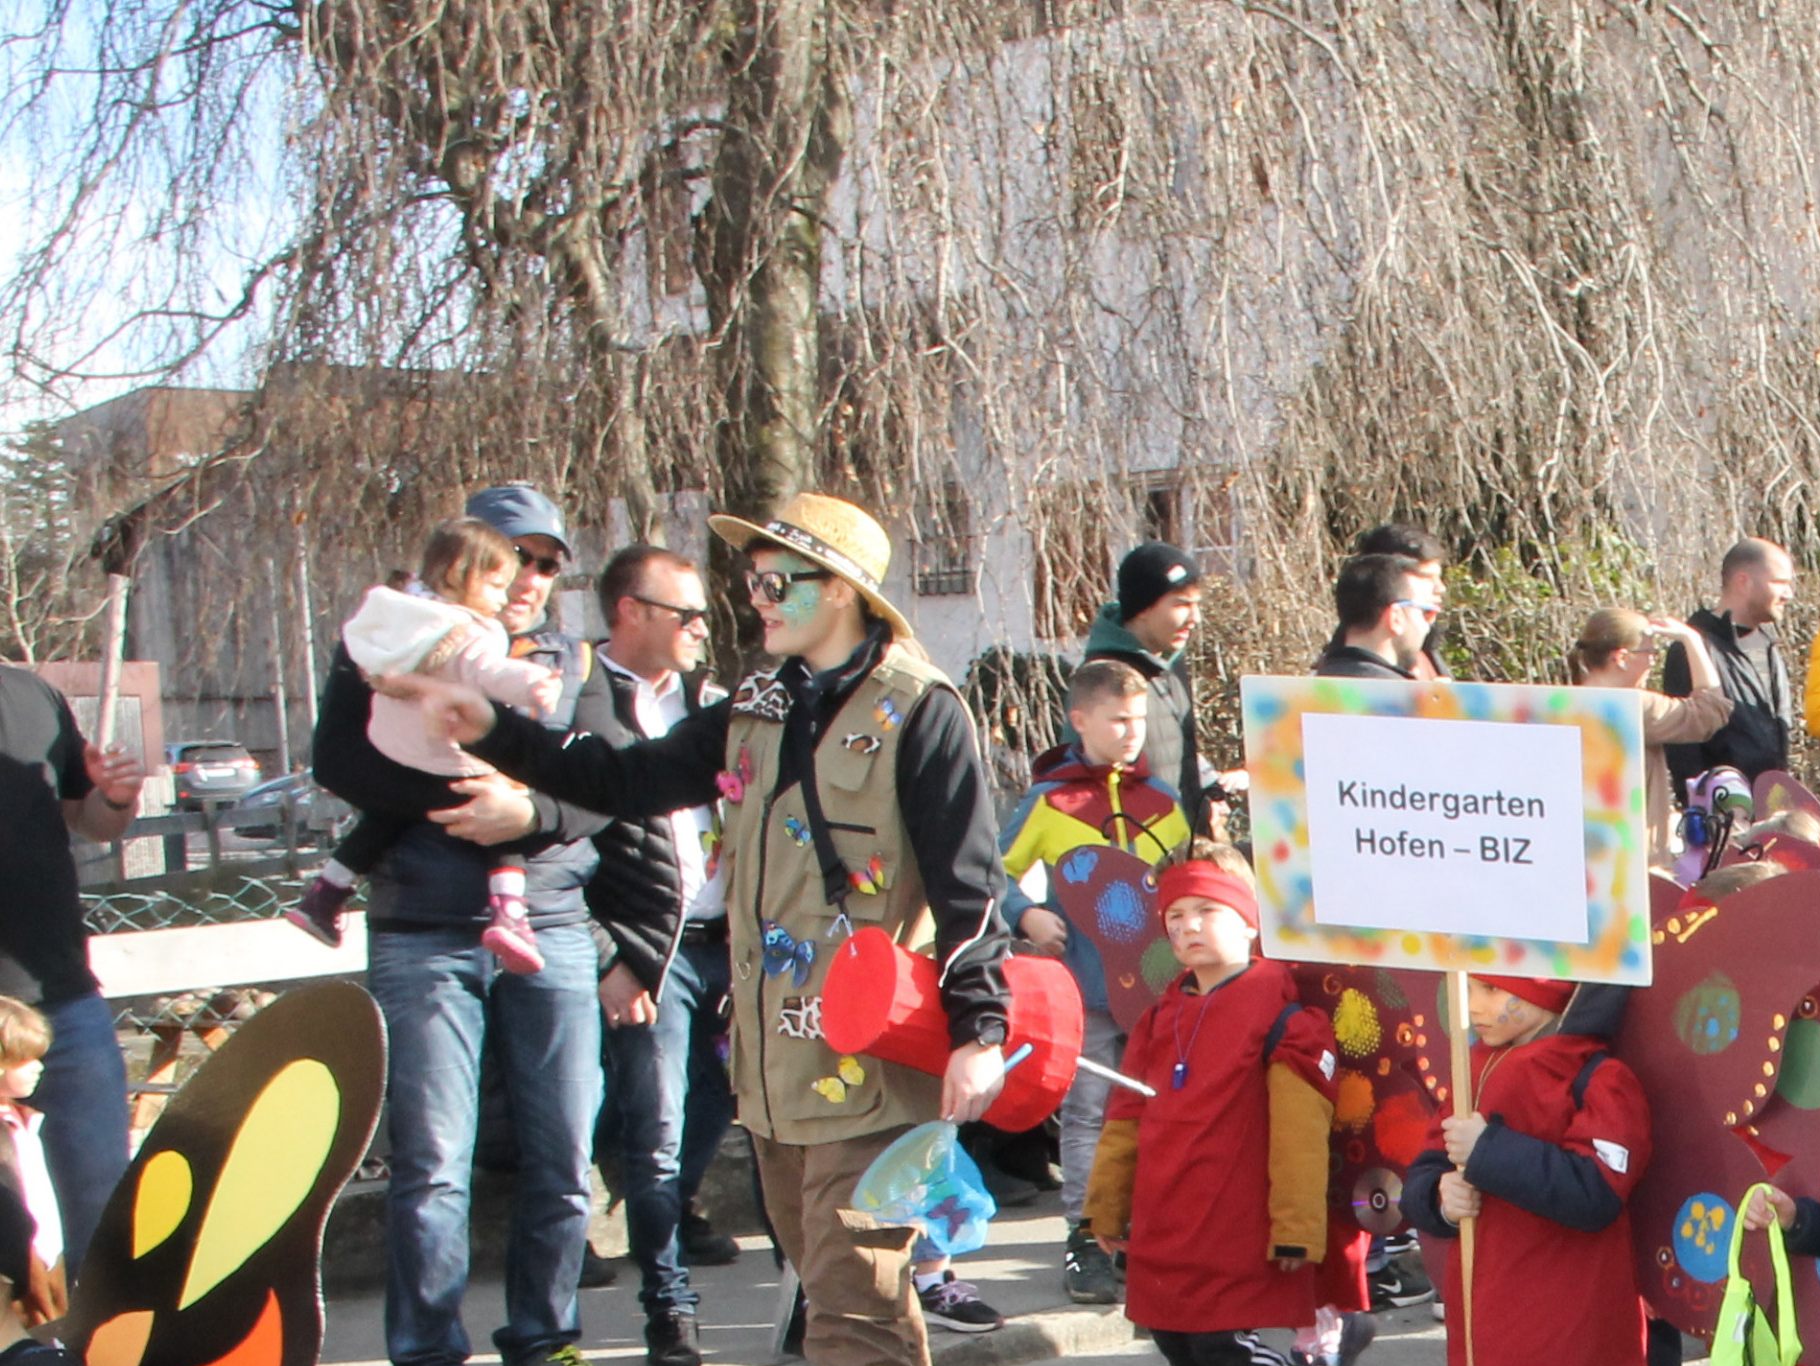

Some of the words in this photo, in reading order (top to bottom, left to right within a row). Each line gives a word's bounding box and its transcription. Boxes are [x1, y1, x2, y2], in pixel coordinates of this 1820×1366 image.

[1338, 780, 1545, 819] Kindergarten
[1355, 827, 1445, 859] Hofen
[1479, 836, 1534, 864] BIZ
